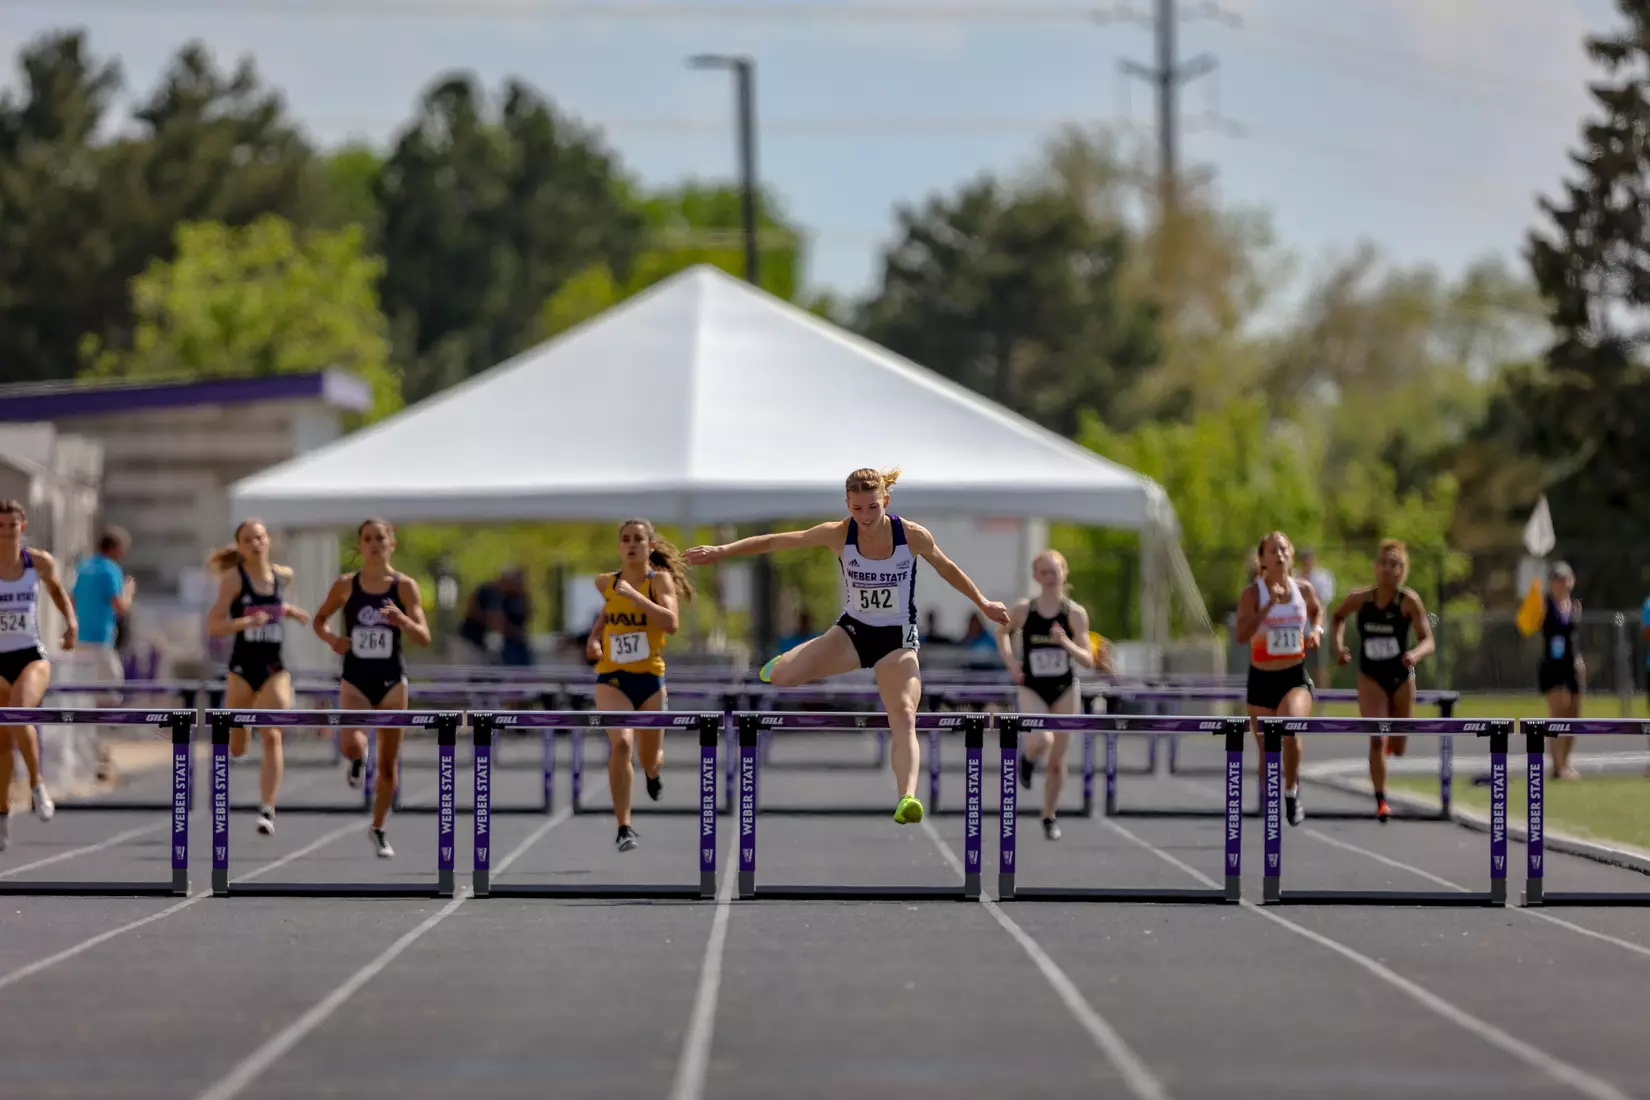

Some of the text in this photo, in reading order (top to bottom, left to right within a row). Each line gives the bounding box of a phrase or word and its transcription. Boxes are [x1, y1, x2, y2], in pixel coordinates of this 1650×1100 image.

[847, 568, 907, 583] WEBER STATE
[860, 589, 893, 609] 542
[0, 615, 26, 631] 524
[359, 631, 386, 650] 264
[615, 635, 640, 655] 357
[1273, 631, 1296, 648] 211
[145, 714, 169, 722] GILL
[234, 715, 257, 723] GILL
[412, 715, 435, 724] GILL
[495, 716, 519, 724] GILL
[672, 716, 697, 725] GILL
[761, 717, 785, 725] GILL
[938, 718, 962, 726] GILL
[1021, 719, 1045, 727] GILL
[1199, 721, 1222, 729] GILL
[1285, 722, 1308, 731] GILL
[1463, 723, 1486, 731] GILL
[1548, 723, 1571, 731] GILL
[176, 755, 186, 833] WEBER STATE
[215, 755, 226, 834] WEBER STATE
[442, 756, 452, 835] WEBER STATE
[477, 757, 488, 835] WEBER STATE
[703, 758, 714, 836] WEBER STATE
[743, 757, 753, 836] WEBER STATE
[968, 759, 979, 838] WEBER STATE
[1003, 759, 1014, 838] WEBER STATE
[1228, 762, 1240, 840] WEBER STATE
[1267, 763, 1278, 840] WEBER STATE
[1531, 764, 1540, 842] WEBER STATE
[1494, 764, 1504, 843] WEBER STATE
